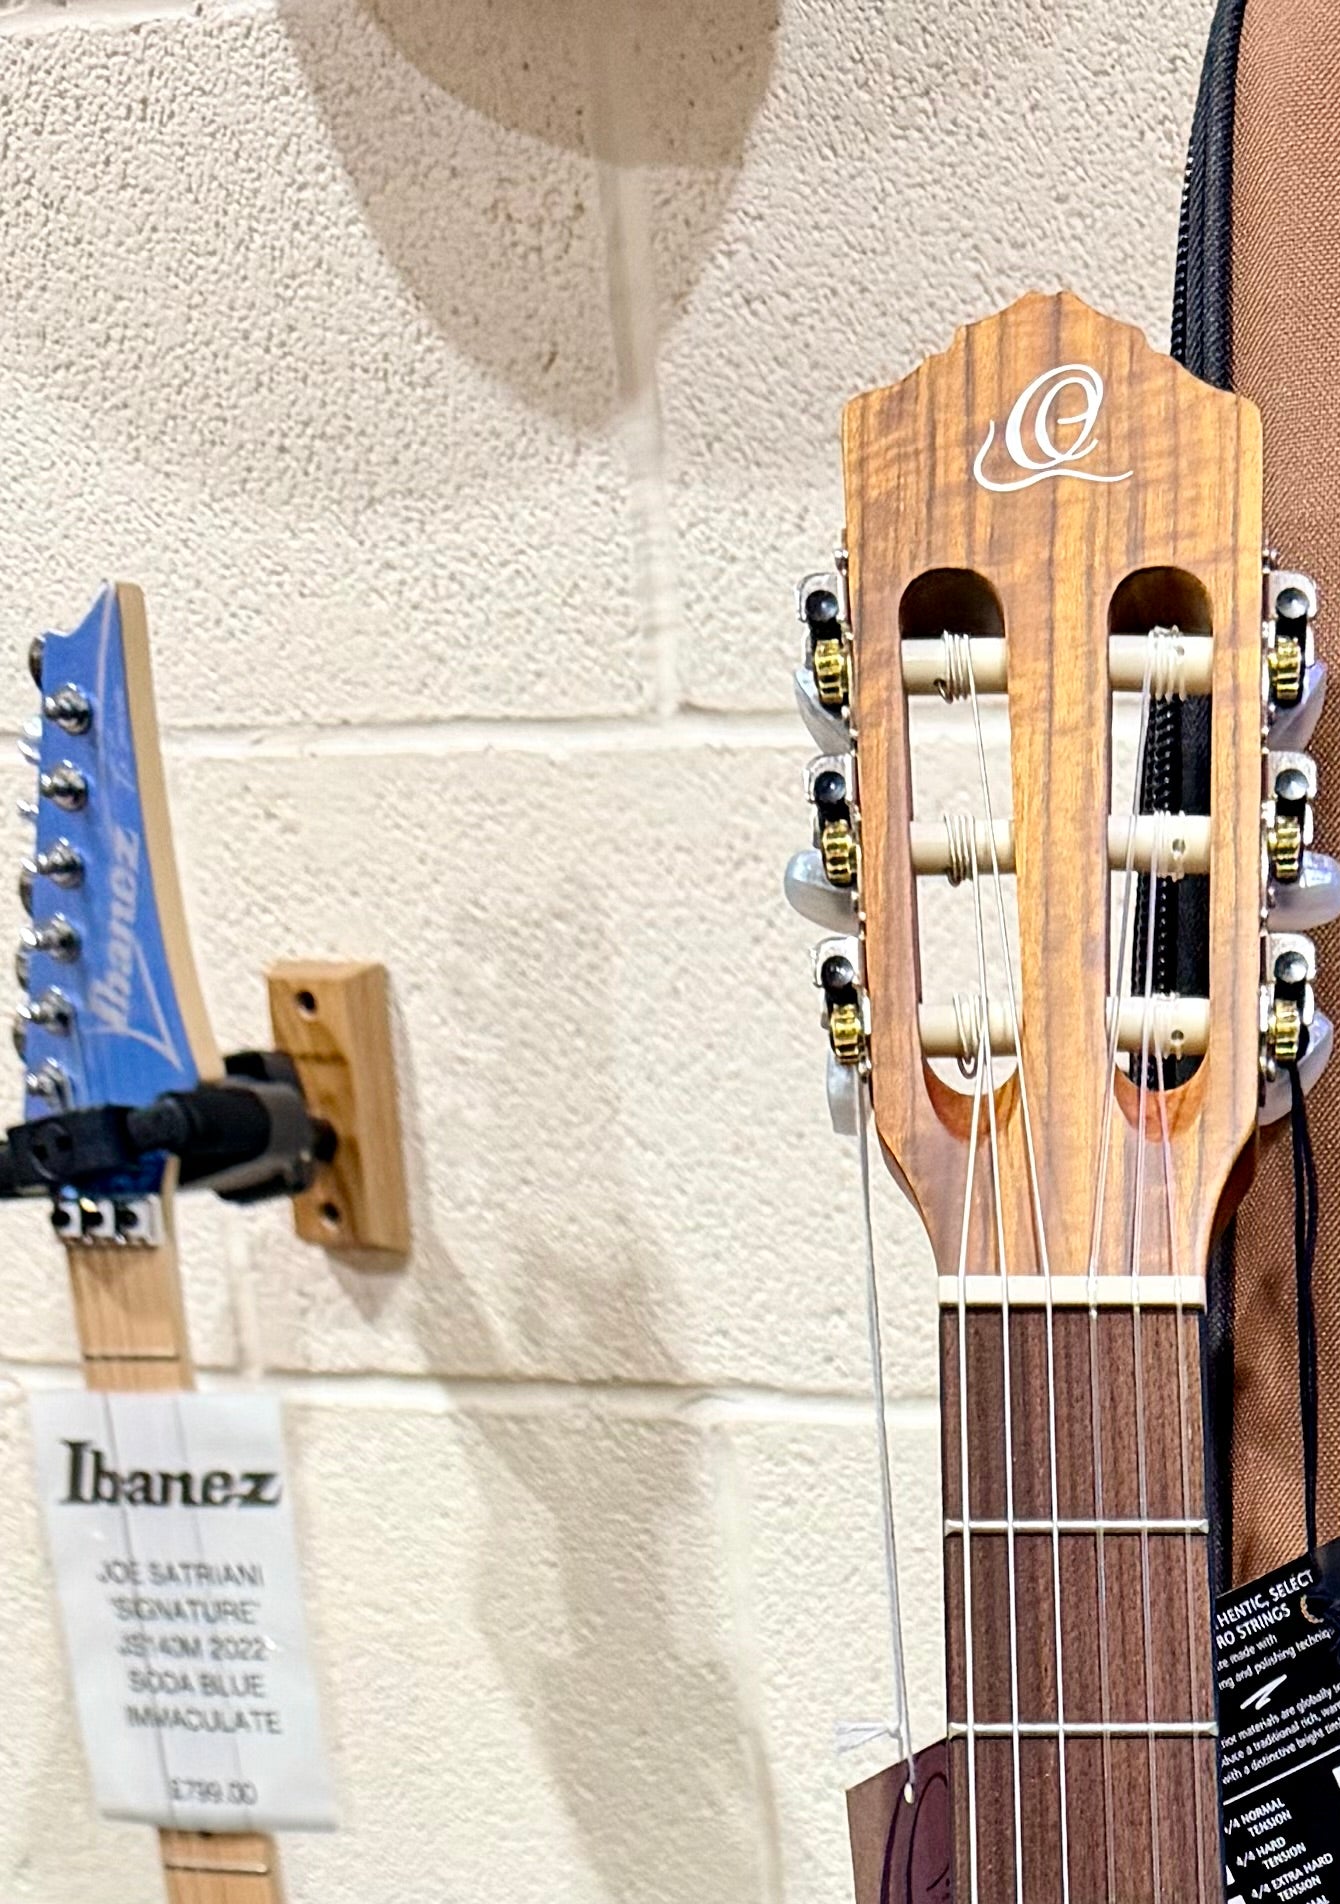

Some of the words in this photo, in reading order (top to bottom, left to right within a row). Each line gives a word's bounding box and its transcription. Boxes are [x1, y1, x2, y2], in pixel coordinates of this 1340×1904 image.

[59, 1438, 283, 1508] Ibanez
[96, 1560, 143, 1585] JOE
[149, 1560, 265, 1588] SATRIANI
[1214, 1593, 1270, 1630] HENTIC,
[1268, 1569, 1314, 1602] SELECT
[1215, 1630, 1236, 1650] RO
[1235, 1602, 1291, 1640] STRINGS
[207, 1634, 269, 1662] 2022
[1218, 1676, 1236, 1691] ing
[1235, 1664, 1253, 1682] and
[1253, 1646, 1297, 1675] polishing
[1295, 1628, 1335, 1652] techniq
[1229, 1645, 1256, 1664] made
[1255, 1633, 1278, 1651] with
[127, 1669, 195, 1694] SODA
[200, 1673, 266, 1698] BLUE
[125, 1705, 282, 1734] IMMACULATE
[1220, 1734, 1238, 1749] rior
[1237, 1713, 1280, 1741] materials
[1280, 1706, 1296, 1720] are
[1296, 1687, 1332, 1714] globally
[1221, 1750, 1245, 1768] duce
[1252, 1720, 1300, 1752] traditional
[1250, 1742, 1297, 1772] distinctive
[1295, 1727, 1325, 1749] bright
[1240, 1797, 1286, 1825] NORMAL
[1247, 1809, 1293, 1838] TENSION
[1236, 1850, 1256, 1868] 4/4
[1255, 1836, 1287, 1858] HARD
[1261, 1841, 1307, 1870] TENSION
[1251, 1883, 1272, 1900] 4/4
[1270, 1867, 1304, 1891] EXTRA
[1302, 1852, 1334, 1875] HARD
[1276, 1874, 1322, 1902] TENSION
